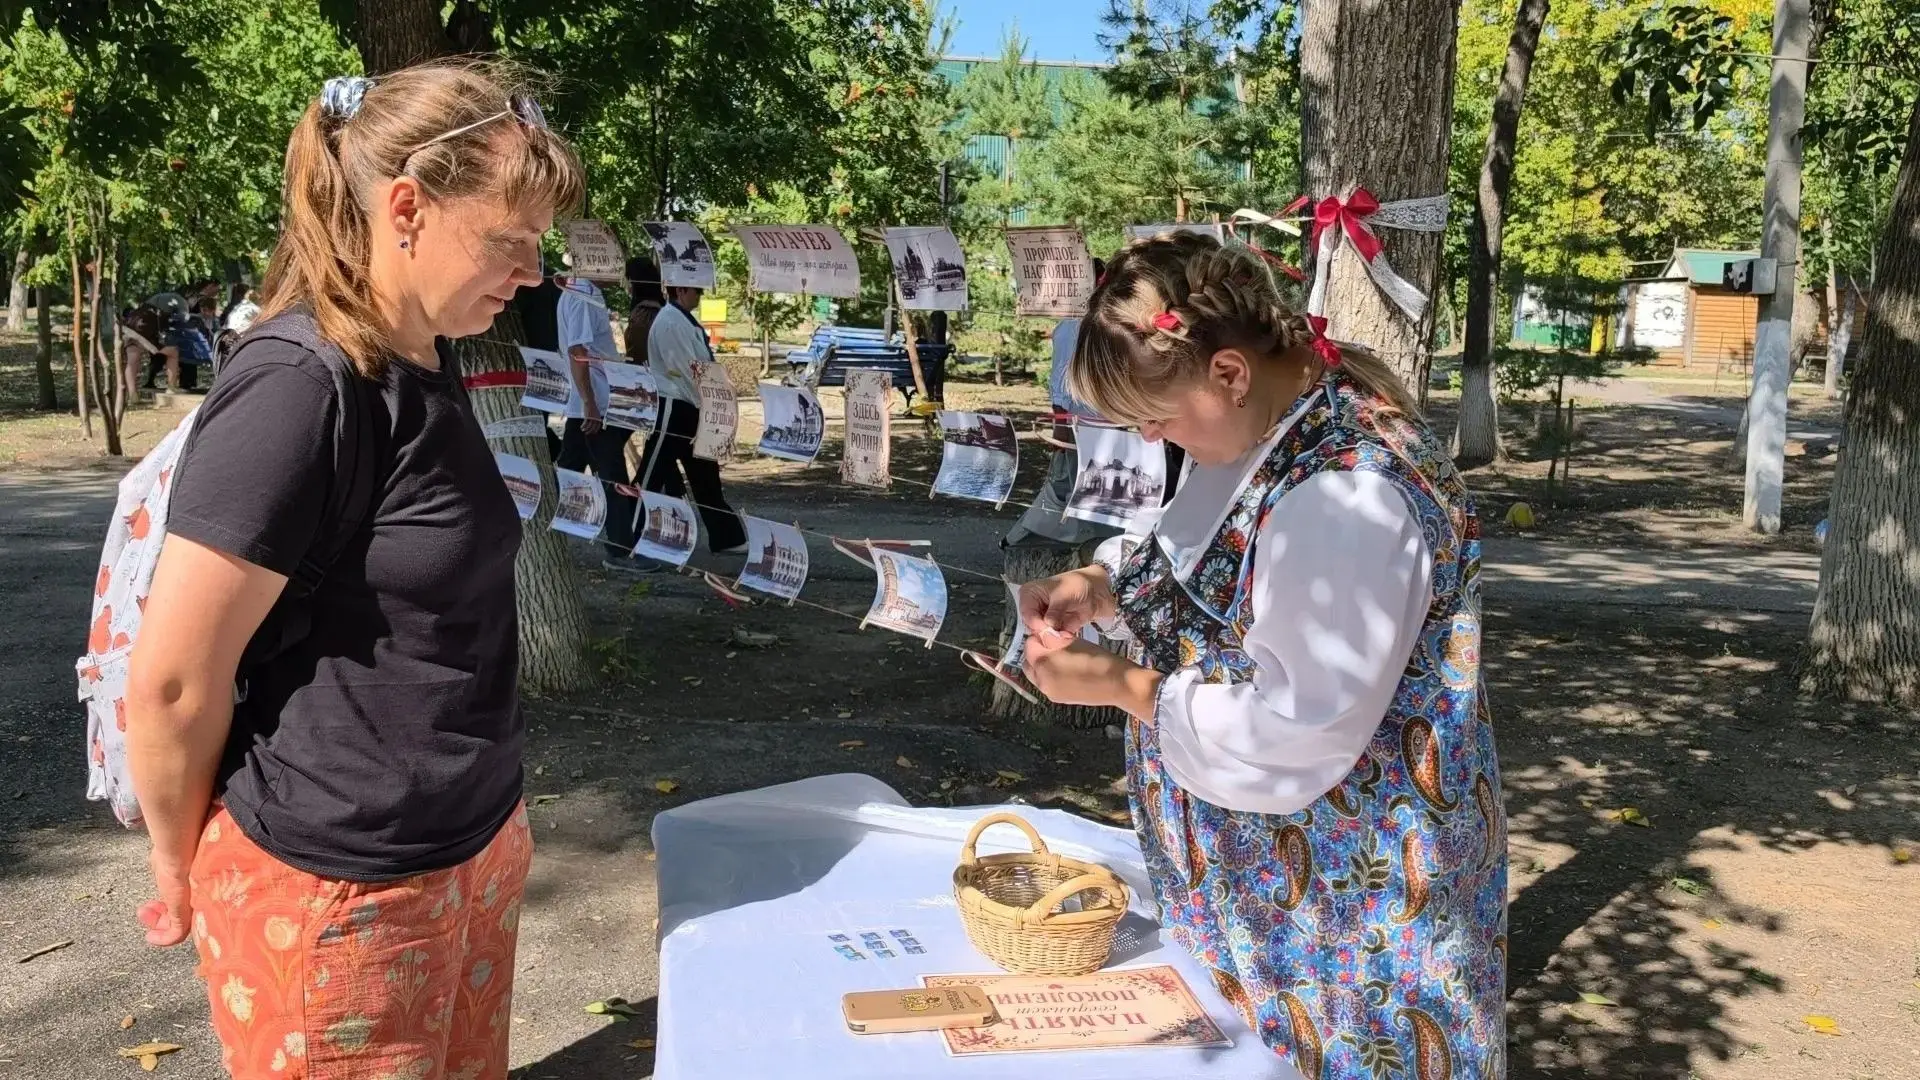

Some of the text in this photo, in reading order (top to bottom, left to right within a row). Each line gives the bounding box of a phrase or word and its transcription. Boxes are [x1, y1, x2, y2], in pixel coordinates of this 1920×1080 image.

[753, 227, 832, 251] ПУГАЧЁВ
[1023, 246, 1080, 262] ПРОШЛОЕ.
[1022, 264, 1088, 281] НАСТОЯЩЕЕ.
[1031, 282, 1082, 299] БУДУЩЕЕ.
[853, 401, 880, 421] ЗДЕСЬ
[851, 432, 884, 453] РОДИНА
[992, 989, 1139, 1005] ПОКОЛЕНИ
[1001, 1012, 1149, 1031] ПАМЯТЬ
